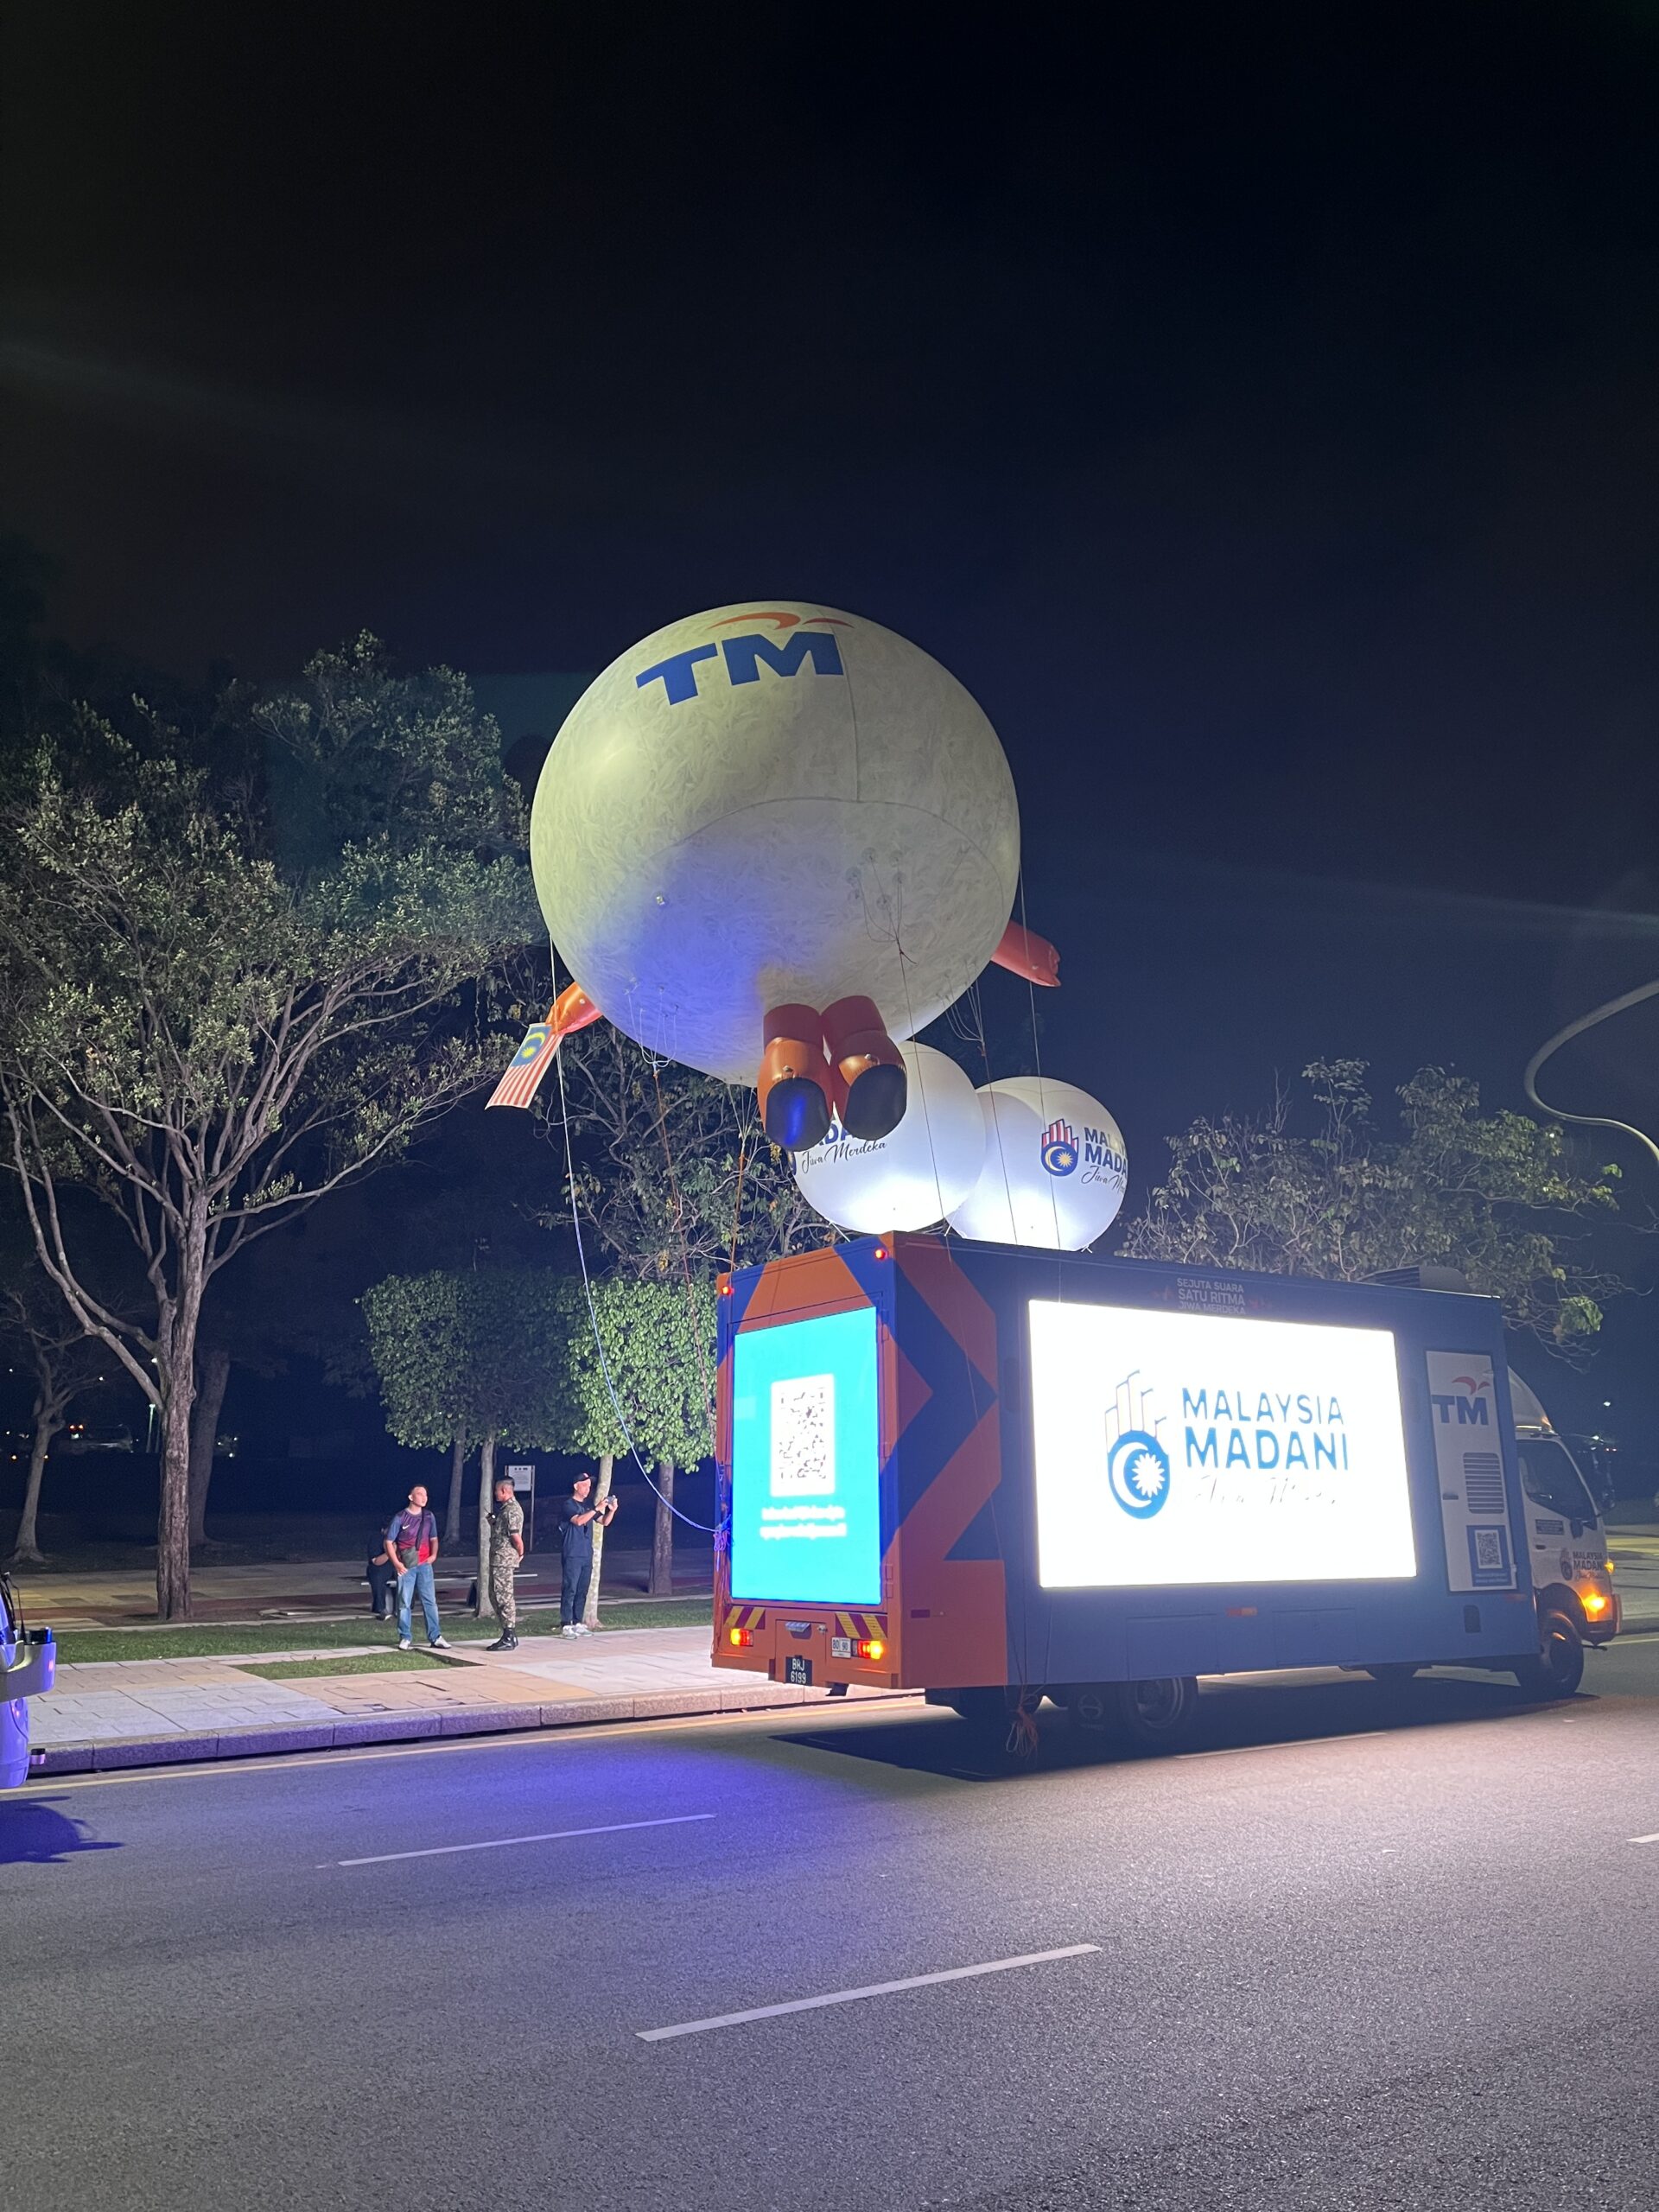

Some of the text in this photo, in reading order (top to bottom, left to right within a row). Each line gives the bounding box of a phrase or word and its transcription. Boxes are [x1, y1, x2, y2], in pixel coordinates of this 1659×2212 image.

[636, 632, 844, 706] TM
[824, 1139, 886, 1164] Merdeka
[1085, 1143, 1127, 1179] MADA
[1176, 1278, 1244, 1294] SEJUTA SUARA
[1178, 1287, 1246, 1306] SATU RITMA
[1178, 1300, 1246, 1315] JIWA MERDEKA
[1181, 1387, 1344, 1425] MALAYSIA
[1431, 1394, 1489, 1426] TM
[1185, 1426, 1349, 1471] MADANI
[791, 1671, 806, 1684] 6199
